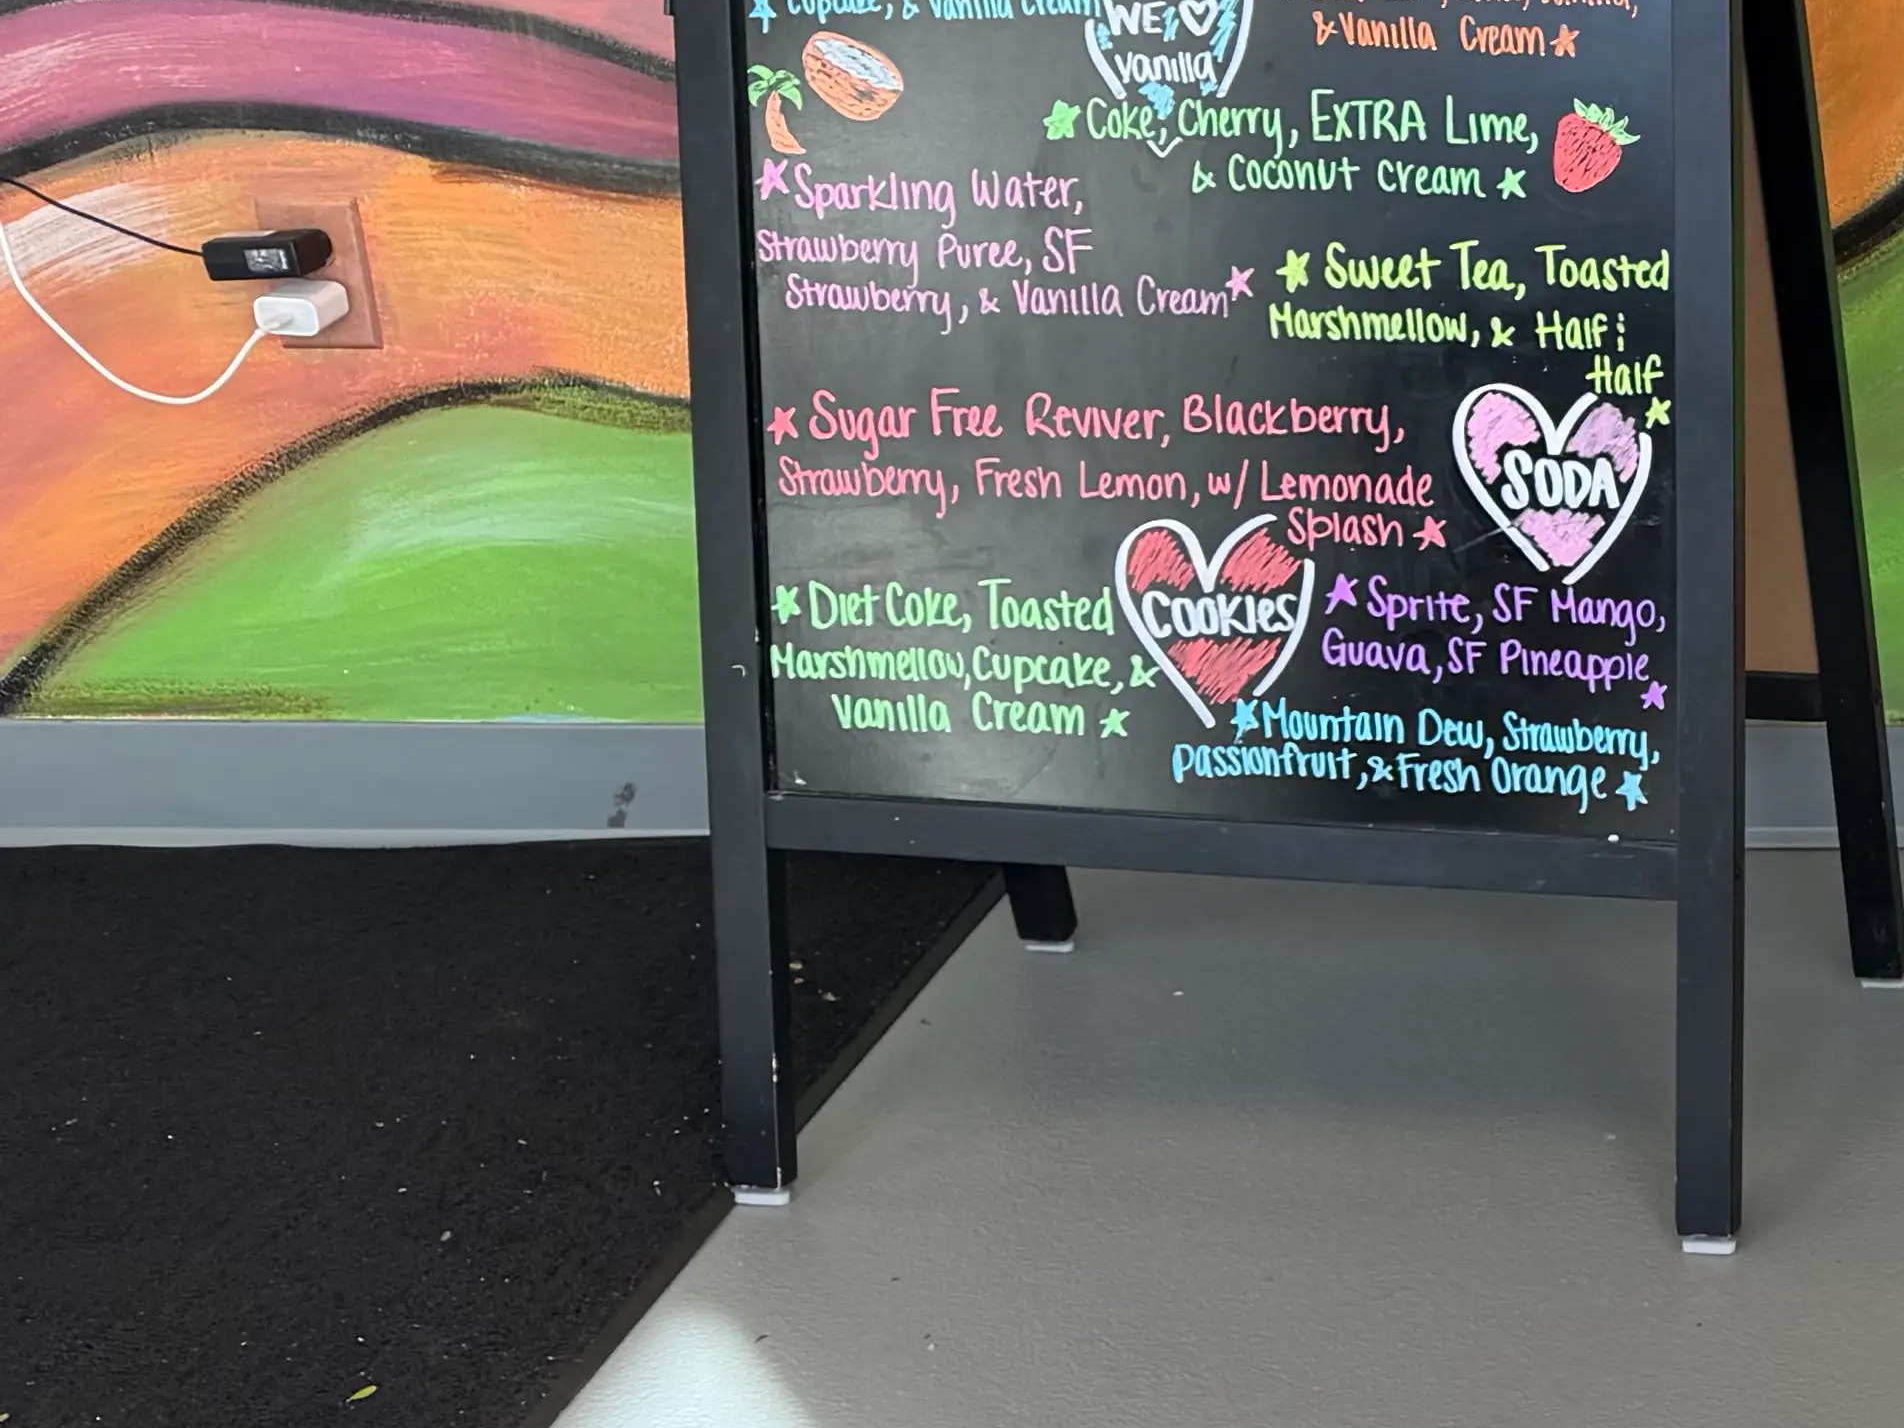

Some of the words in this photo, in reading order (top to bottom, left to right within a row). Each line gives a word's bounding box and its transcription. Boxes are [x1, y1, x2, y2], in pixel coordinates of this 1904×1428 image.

[1312, 11, 1337, 46] &
[1339, 13, 1437, 52] Vanilla
[1460, 15, 1546, 57] Cream
[1087, 97, 1167, 145] Coke,
[1178, 98, 1298, 160] Cherry,
[1310, 88, 1426, 145] EXTRA
[1445, 95, 1539, 154] Lime,
[794, 162, 956, 228] Sparkling
[972, 168, 1083, 215] Water,
[1192, 161, 1216, 194] &
[756, 228, 919, 288] Strawberry
[938, 233, 1033, 275] Puree,
[1042, 225, 1093, 274] SF
[1324, 240, 1441, 291] Sweet
[1449, 239, 1526, 301] Tea,
[1535, 244, 1670, 292] Toasted
[784, 272, 969, 335] Strawberry,
[979, 288, 1000, 314] &
[1012, 278, 1124, 317] Vanilla
[1136, 276, 1229, 319] Cream
[1268, 301, 1480, 348] Marshmellow,
[1535, 310, 1610, 350] Half
[1585, 353, 1665, 398] Half
[808, 388, 916, 460] Sugar
[930, 387, 1003, 438] Free
[1025, 392, 1171, 448] Reviver,
[1182, 393, 1405, 456] Blackberry,
[778, 455, 959, 518] Strawberry,
[975, 457, 1062, 499] Fresh
[1079, 460, 1201, 508] Lemon,
[1260, 460, 1435, 507] Lemonade
[1500, 449, 1621, 510] SODA
[1286, 506, 1403, 552] Splash
[808, 580, 880, 630] Diet
[885, 581, 972, 634] Coke,
[977, 577, 1115, 635] Toasted
[1366, 574, 1485, 635] Sprite,
[1492, 583, 1539, 610] SF
[1549, 591, 1667, 647] Mango,
[770, 643, 971, 690] Marshmellow,
[971, 645, 1124, 695] Cupcake,
[1128, 654, 1160, 689] &
[1321, 627, 1444, 684] Guava,
[1447, 640, 1487, 674] SF
[1499, 639, 1649, 693] Pineapple
[972, 690, 1086, 737] Cream
[1261, 696, 1404, 743] Mountain
[1417, 707, 1493, 759] Dew,
[1502, 710, 1660, 771] Strawberry,
[1366, 756, 1394, 783] &
[1396, 751, 1480, 794] Fresh
[1491, 755, 1607, 815] Orange
